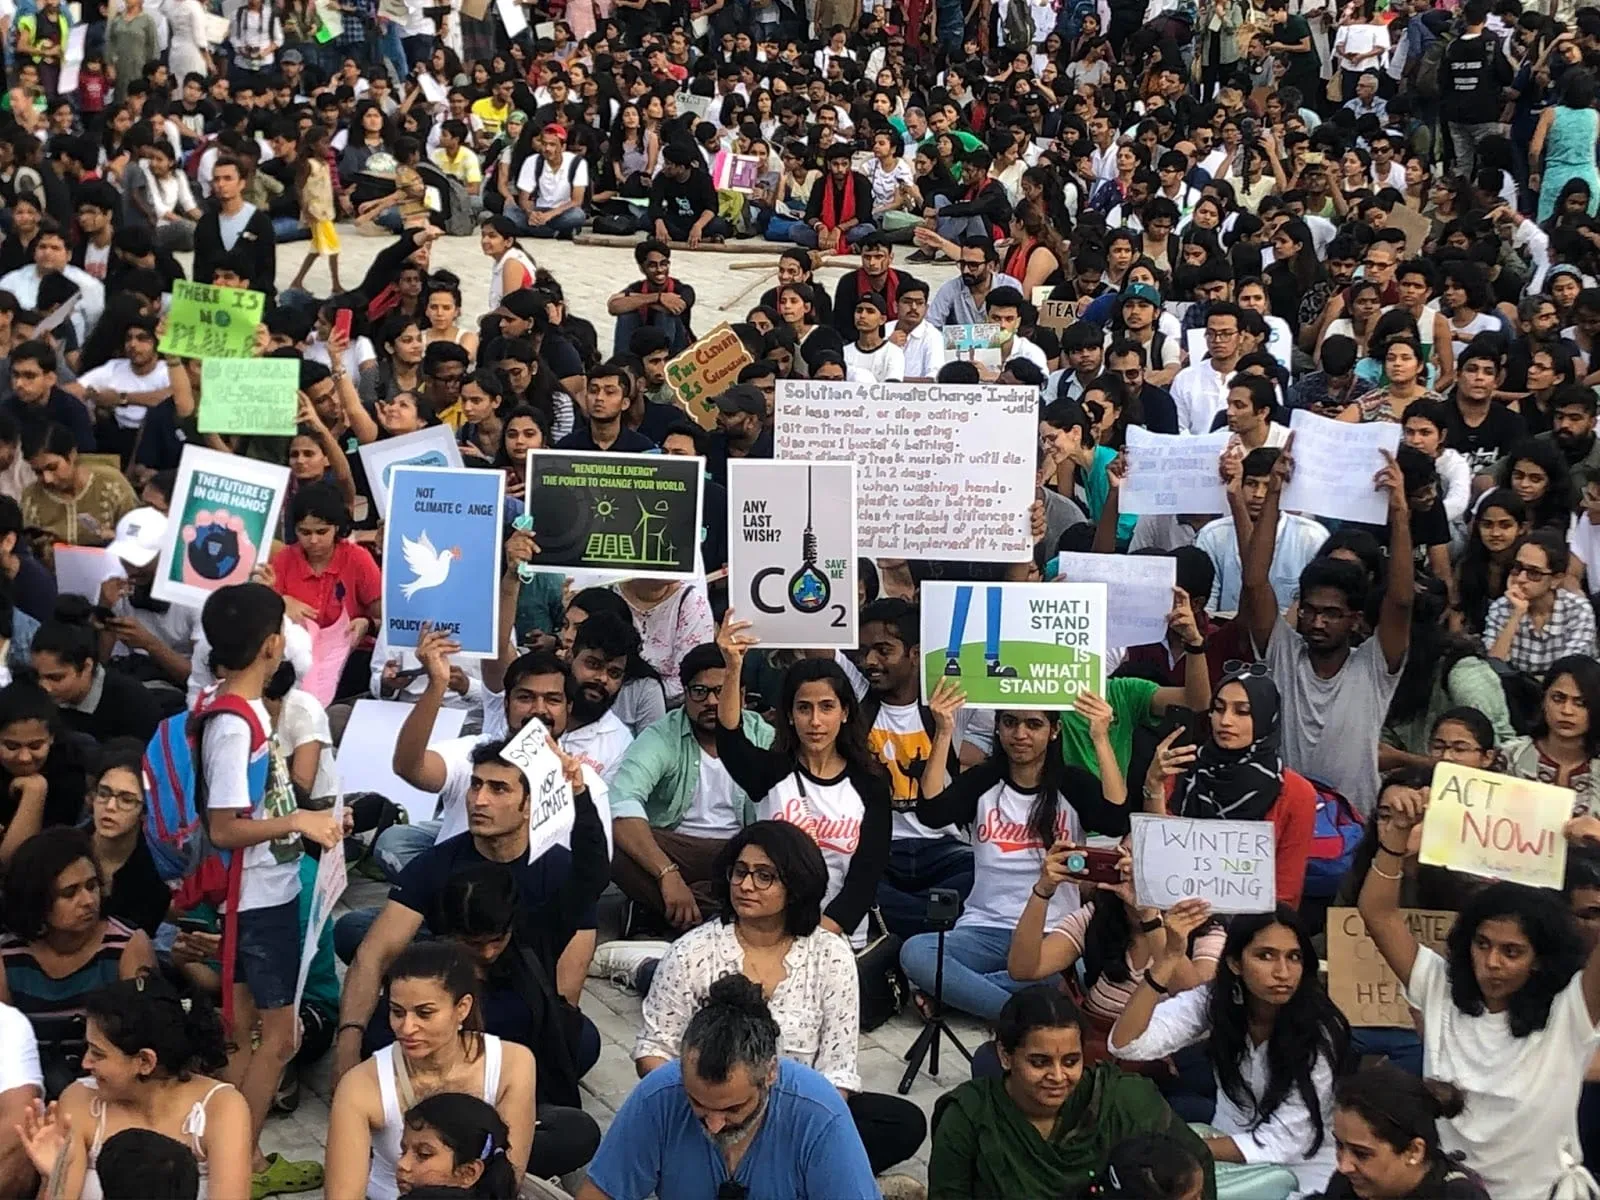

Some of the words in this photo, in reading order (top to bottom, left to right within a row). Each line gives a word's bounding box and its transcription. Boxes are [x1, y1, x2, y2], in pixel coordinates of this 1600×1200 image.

[177, 284, 221, 305] THERE
[784, 382, 853, 400] Solution
[928, 386, 982, 406] Change
[783, 405, 802, 416] Eat
[876, 409, 890, 419] or
[808, 439, 836, 449] max
[848, 438, 890, 450] bucket
[889, 466, 897, 479] 2
[900, 467, 932, 480] days
[198, 473, 219, 489] THE
[218, 479, 259, 499] FUTURE
[259, 489, 271, 501] IS
[542, 475, 557, 486] THE
[558, 475, 587, 487] POWER
[588, 477, 598, 487] TO
[599, 478, 632, 489] CHANGE
[633, 480, 655, 490] YOUR
[655, 480, 687, 492] WORLD.
[862, 480, 900, 493] when
[904, 481, 959, 496] washing
[965, 480, 1007, 494] hands
[193, 486, 206, 499] IN
[206, 490, 231, 505] OUR
[230, 495, 268, 514] HANDS
[415, 487, 436, 499] NOT
[414, 501, 453, 515] CLIMATE
[742, 500, 768, 514] ANY
[743, 514, 773, 528] LAST
[743, 528, 782, 543] WISH?
[824, 559, 848, 570] SAVE
[830, 569, 845, 580] ME
[1028, 599, 1081, 615] WHAT
[1084, 600, 1090, 615] I
[389, 618, 420, 631] POLICY
[1030, 615, 1090, 630] STAND
[1055, 632, 1090, 646] FOR
[1073, 647, 1092, 664] IS
[1028, 663, 1081, 679] WHAT
[1085, 664, 1091, 679] I
[999, 679, 1060, 695] STAND
[1063, 680, 1091, 697] ON
[1437, 775, 1503, 810] ACT
[1161, 820, 1270, 858] WINTER
[1460, 810, 1556, 858] NOW!
[1193, 856, 1212, 872] IS
[1219, 857, 1264, 873] NOT
[1165, 874, 1264, 901] COMING
